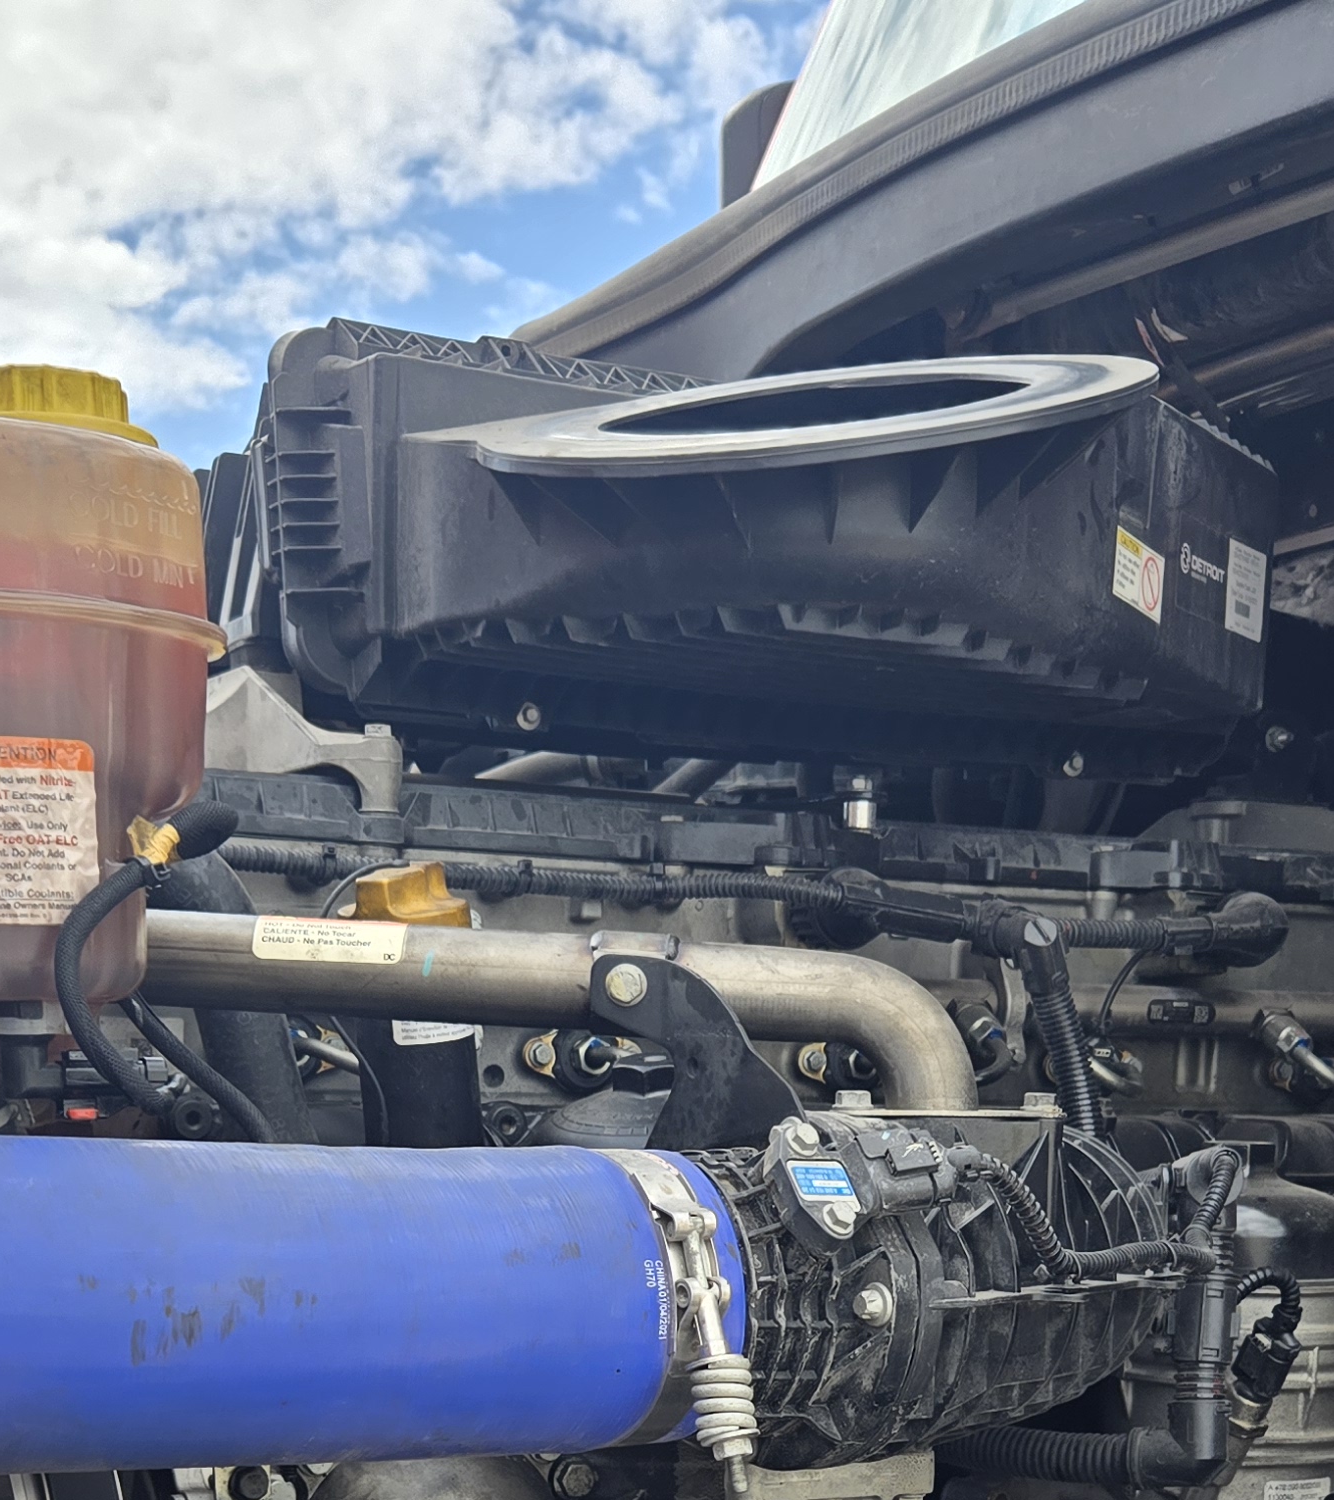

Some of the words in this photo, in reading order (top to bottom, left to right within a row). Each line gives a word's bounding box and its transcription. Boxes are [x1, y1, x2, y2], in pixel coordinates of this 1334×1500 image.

[70, 492, 138, 528] COLD
[148, 507, 182, 540] FILL
[76, 543, 143, 578] COLD
[1191, 555, 1225, 583] DETROIT
[16, 776, 36, 784] with
[12, 792, 56, 801] Extended
[22, 804, 49, 814] (ELC)
[26, 821, 44, 830] Use
[47, 823, 68, 832] Only
[26, 835, 50, 845] OAT
[55, 835, 78, 845] ELC
[12, 850, 25, 858] Do
[29, 850, 44, 858] Not
[47, 850, 65, 859] Add
[24, 862, 65, 871] Coolants
[6, 873, 32, 882] SCAs
[336, 939, 371, 947] Toucher
[383, 953, 396, 961] DC
[644, 1259, 656, 1287] GH70
